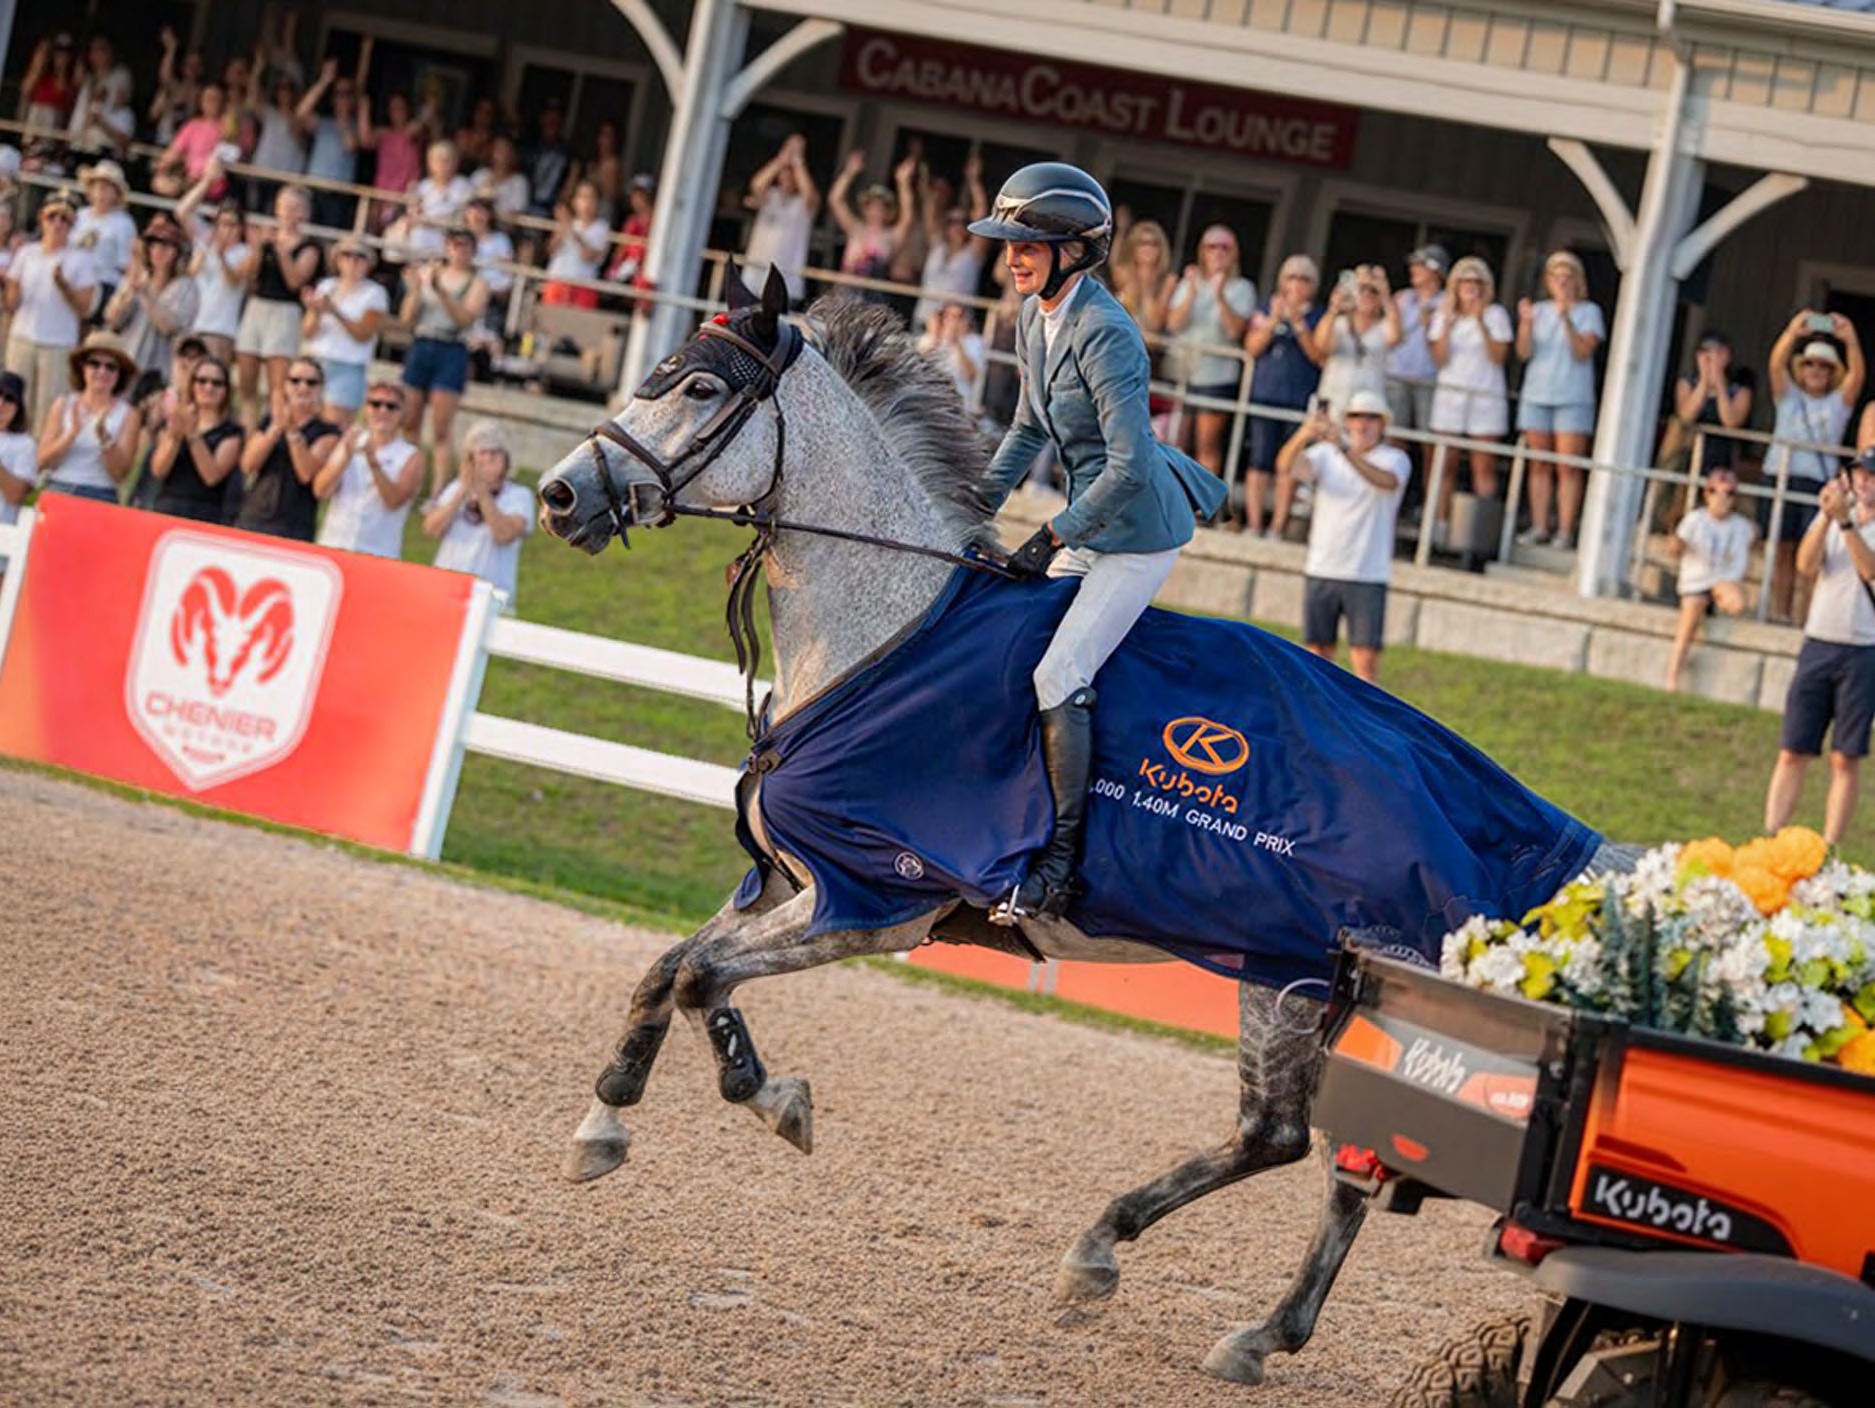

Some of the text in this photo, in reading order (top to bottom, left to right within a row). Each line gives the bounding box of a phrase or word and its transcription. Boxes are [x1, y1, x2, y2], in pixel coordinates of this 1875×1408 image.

[145, 690, 277, 742] CHENIER
[1138, 758, 1239, 813] Kubota
[1131, 790, 1180, 819] 1.40M
[1184, 808, 1248, 842] GRAND
[1252, 831, 1297, 857] PRIX
[1594, 1174, 1732, 1240] Kubota
